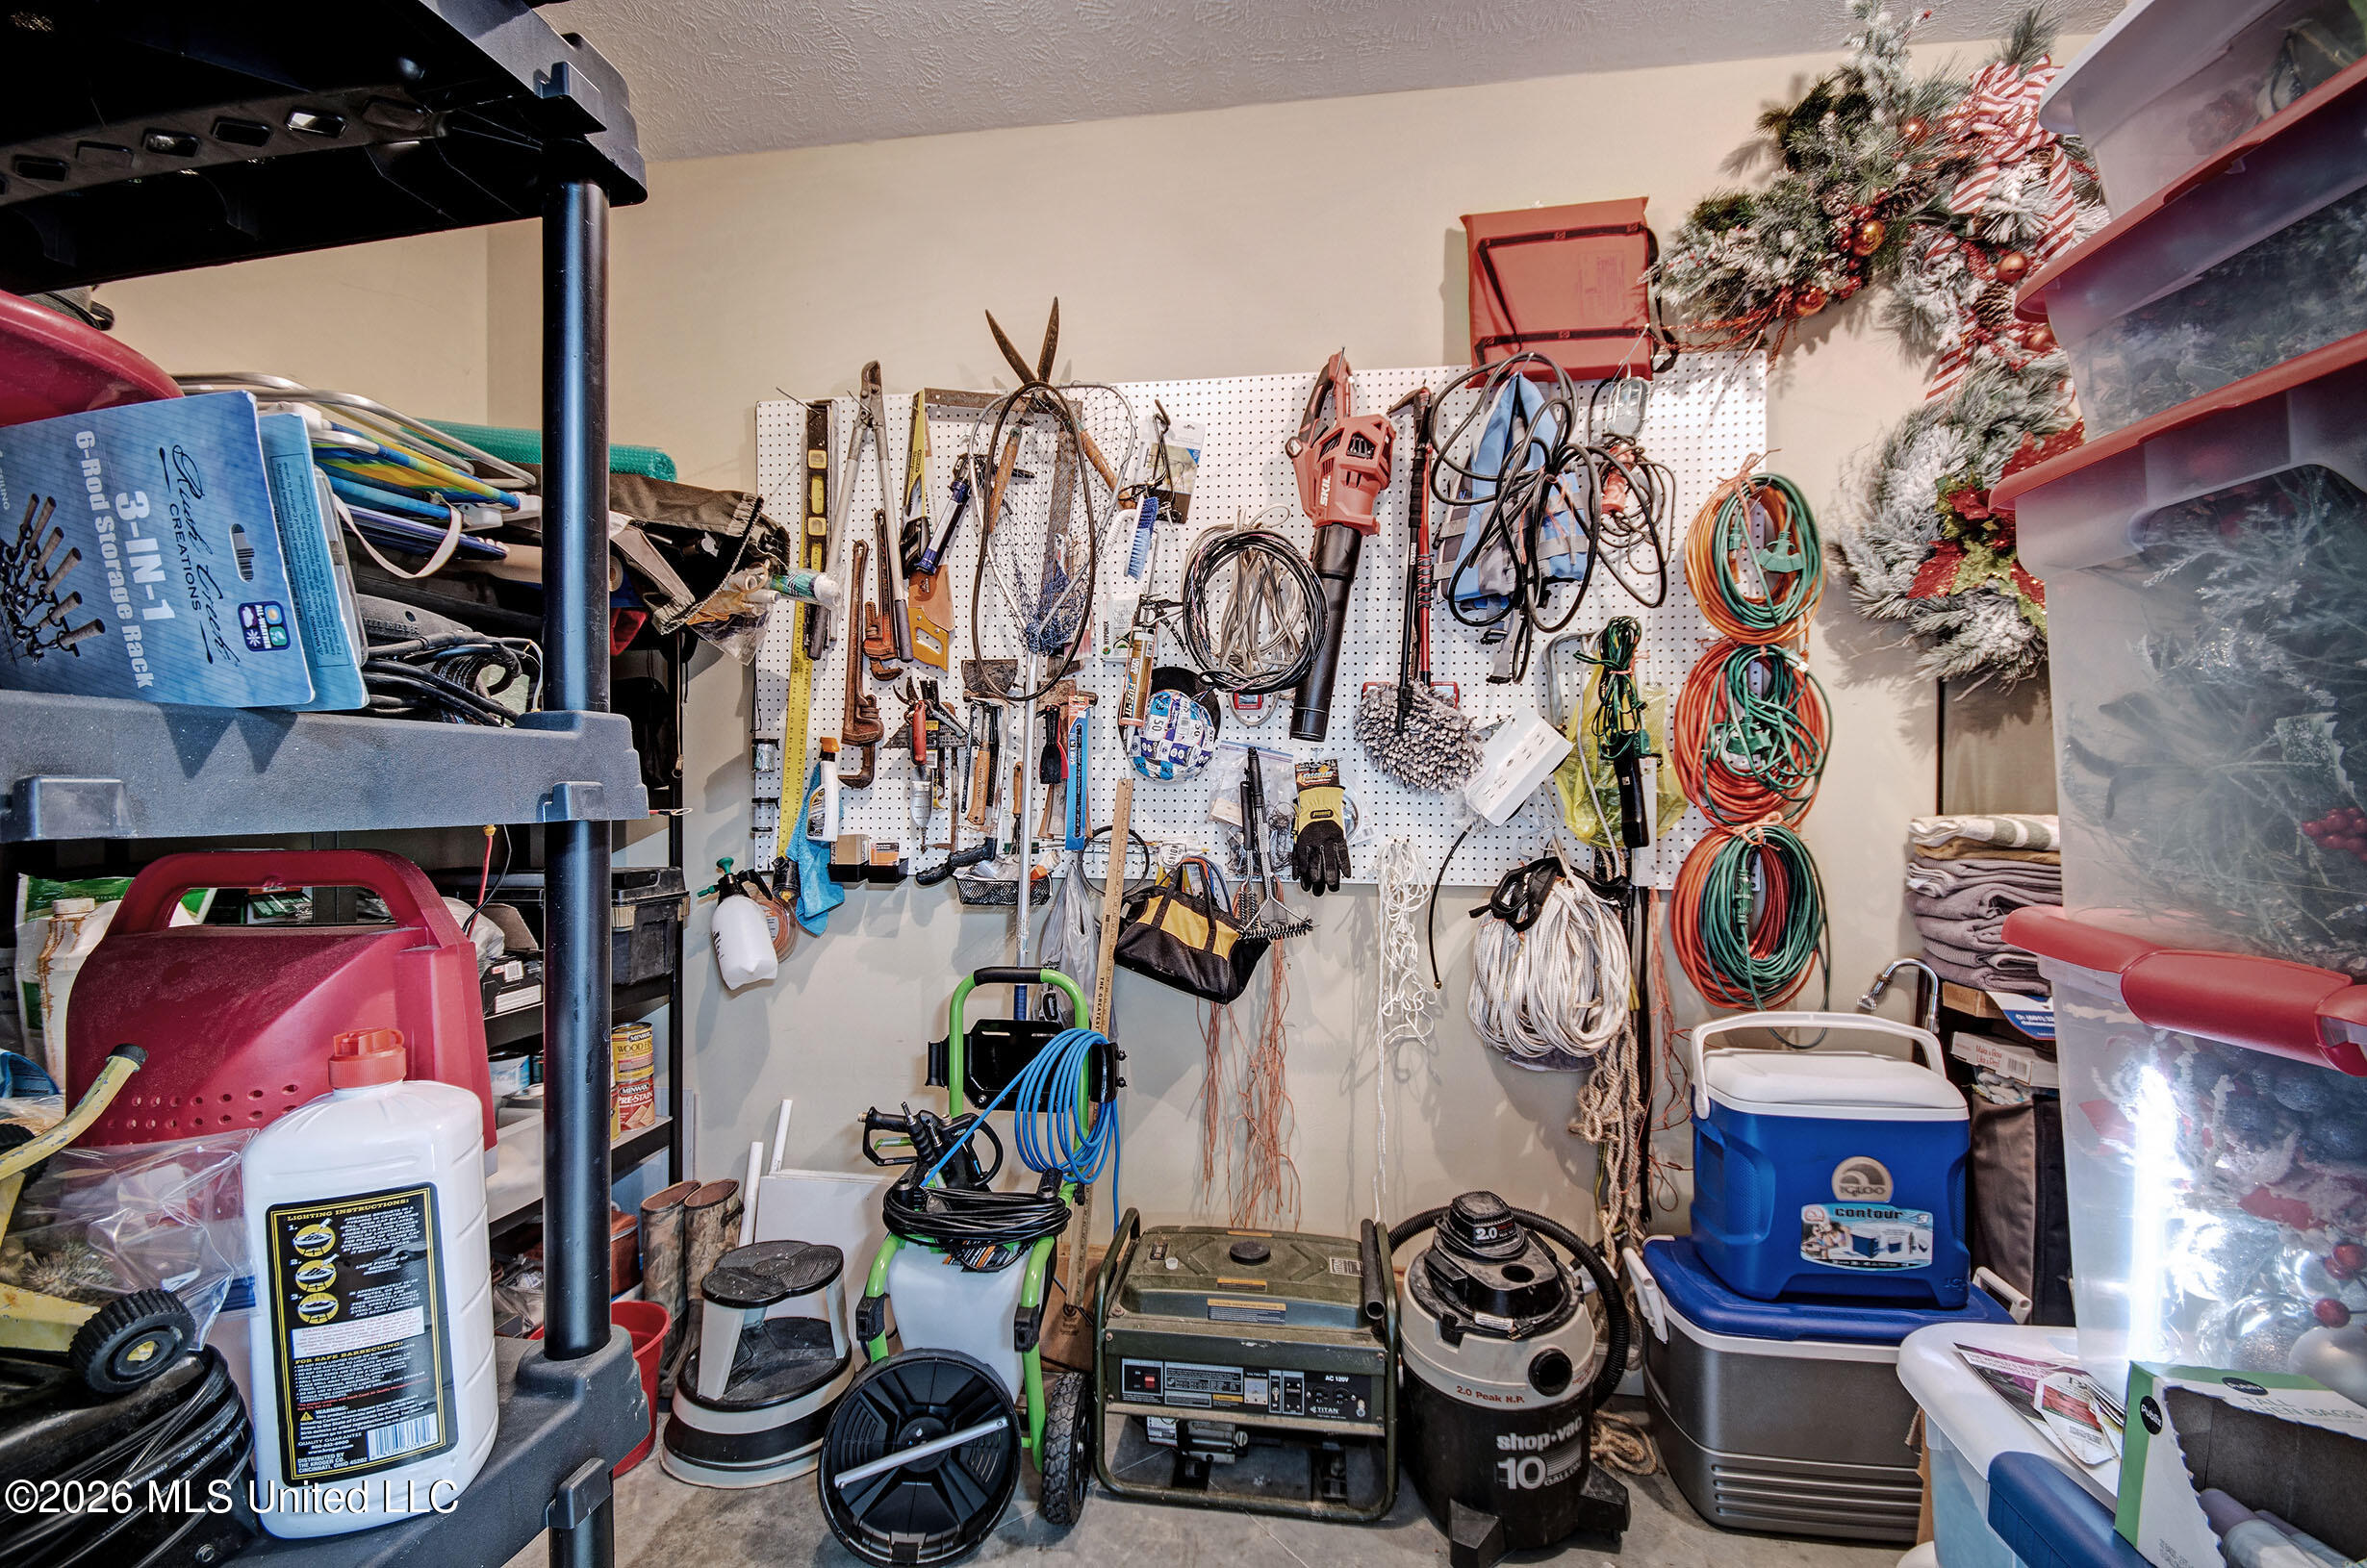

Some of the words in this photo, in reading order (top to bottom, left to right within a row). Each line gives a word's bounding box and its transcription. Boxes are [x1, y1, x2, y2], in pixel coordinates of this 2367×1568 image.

[0, 468, 11, 511] EILING
[1319, 474, 1331, 507] SKIL
[76, 430, 111, 512] 6-Rod
[94, 516, 134, 620] Storage
[121, 624, 155, 689] Rack
[115, 491, 176, 620] 3-IN-1
[169, 503, 202, 612] CREATIONS
[255, 604, 271, 649] ALL-WEATHER
[1151, 719, 1164, 732] 50
[1095, 993, 1104, 1030] GREATEST
[618, 1043, 644, 1053] WOOD
[621, 1083, 646, 1095] MINWAX
[618, 1091, 653, 1104] PRE-STAIN
[287, 1211, 333, 1222] LIGHTING
[335, 1199, 410, 1215] INSTRUCTIONS:
[1835, 1208, 1903, 1219] contour
[1475, 1227, 1498, 1240] 2.0
[341, 1341, 402, 1357] BARBECUING!
[1457, 1385, 1472, 1397] 2.0
[1476, 1391, 1502, 1403] Peak
[2240, 1397, 2297, 1407] TALL
[315, 1404, 347, 1414] WARNING:
[2141, 1404, 2163, 1428] Publix
[2304, 1407, 2364, 1419] BAGS
[297, 1453, 335, 1463] DISTRIBUTED
[298, 1462, 332, 1473] CINCINNATI,
[1497, 1454, 1547, 1490] 10
